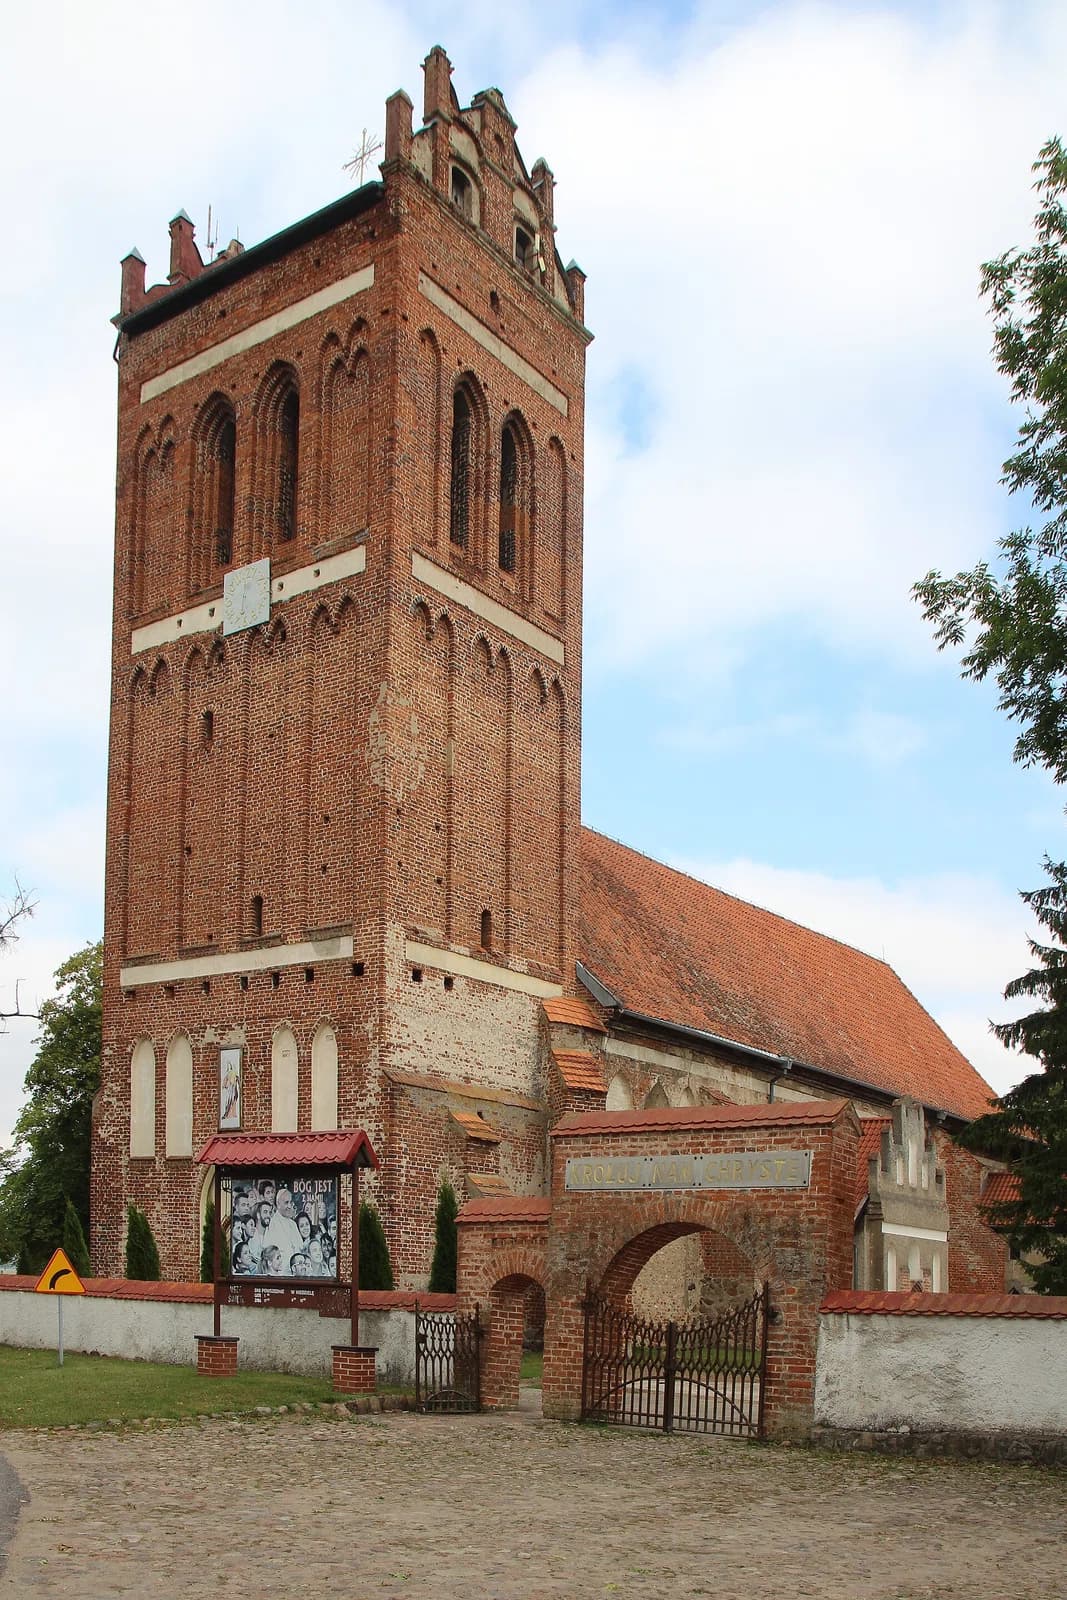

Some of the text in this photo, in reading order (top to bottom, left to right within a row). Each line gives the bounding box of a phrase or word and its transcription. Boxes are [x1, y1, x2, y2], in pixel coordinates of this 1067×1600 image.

[652, 1160, 692, 1185] NAM
[705, 1158, 802, 1183] CHRYSTE
[293, 1178, 333, 1194] BÓG JEST
